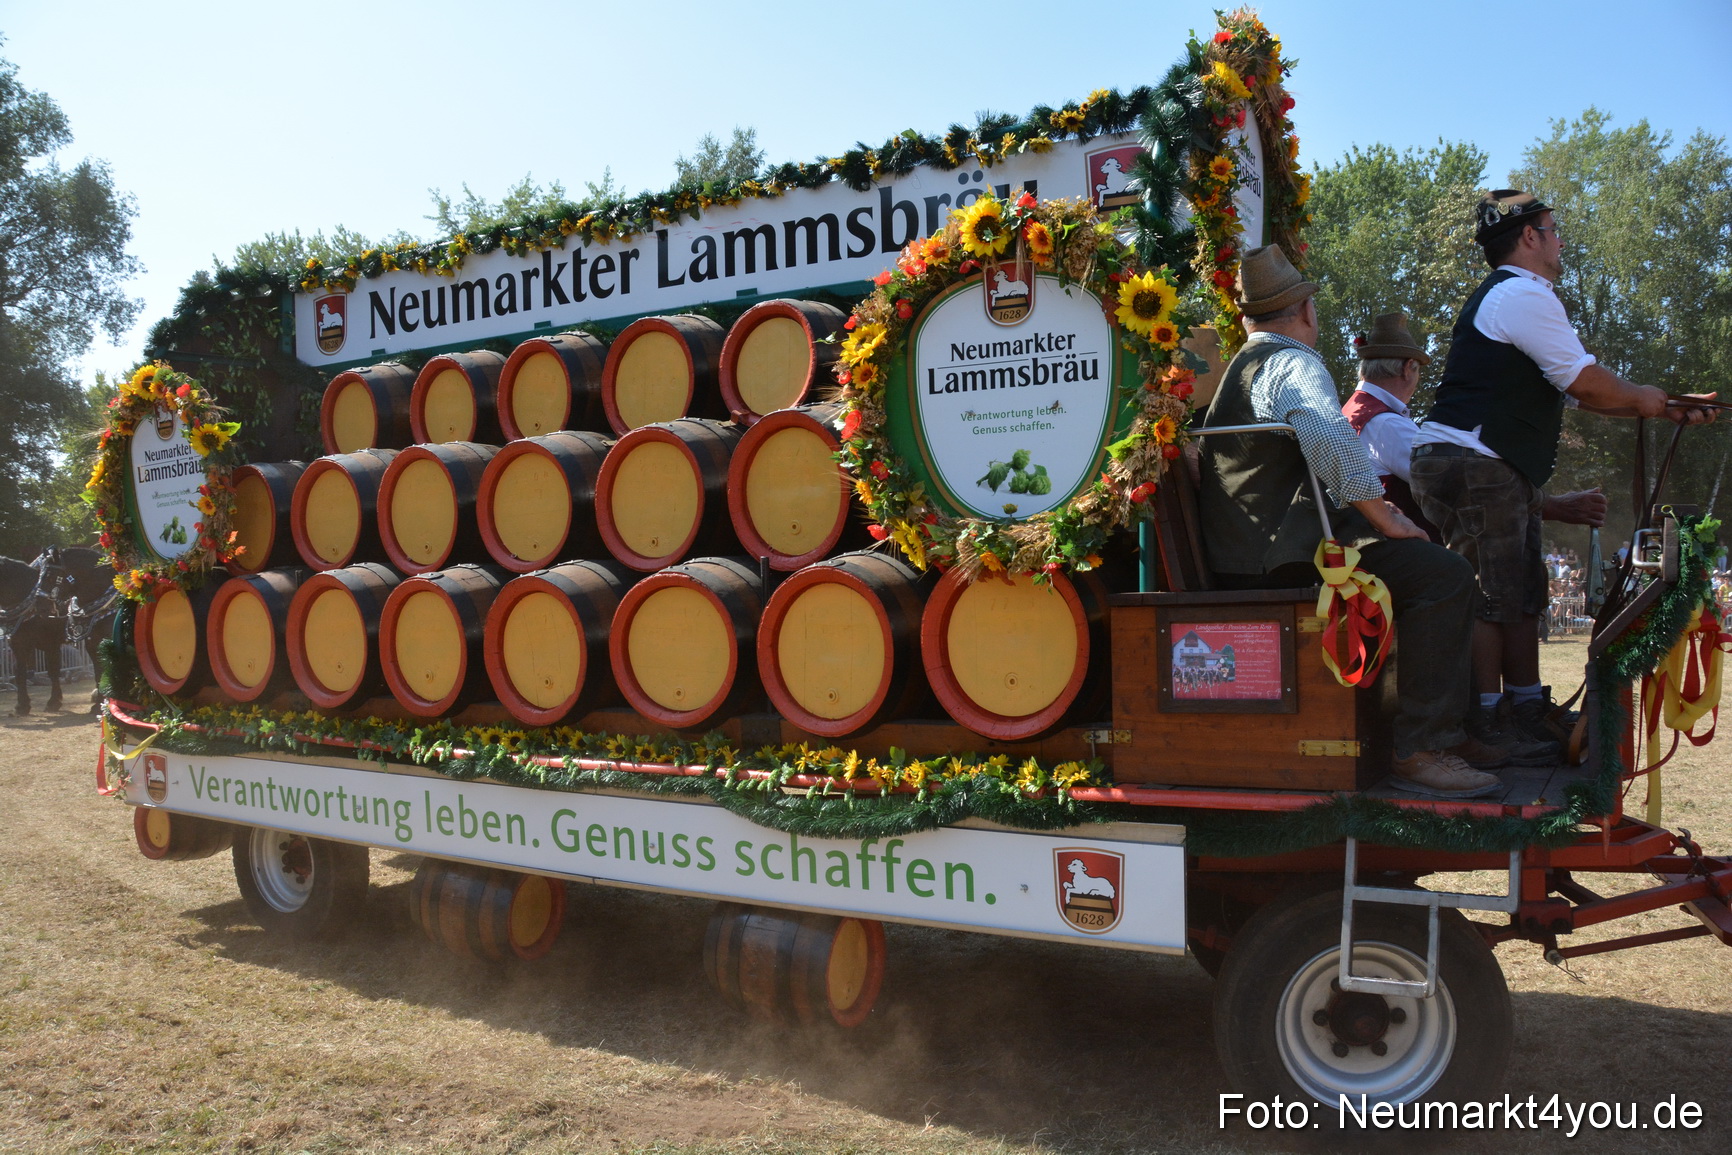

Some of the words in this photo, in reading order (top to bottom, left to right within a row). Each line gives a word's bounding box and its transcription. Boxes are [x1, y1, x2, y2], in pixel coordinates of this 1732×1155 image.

[368, 246, 640, 340] Neumarkter
[999, 309, 1021, 321] 1628
[950, 332, 1076, 362] Neumarkter
[927, 354, 1099, 395] Lammsbräu
[972, 425, 1007, 435] Genuss
[1009, 421, 1055, 433] schaffen.
[188, 764, 413, 843] Verantwortung
[425, 790, 541, 848] leben.
[551, 808, 717, 872] Genuss
[734, 832, 998, 906] schaffen.
[1074, 911, 1105, 927] 1628
